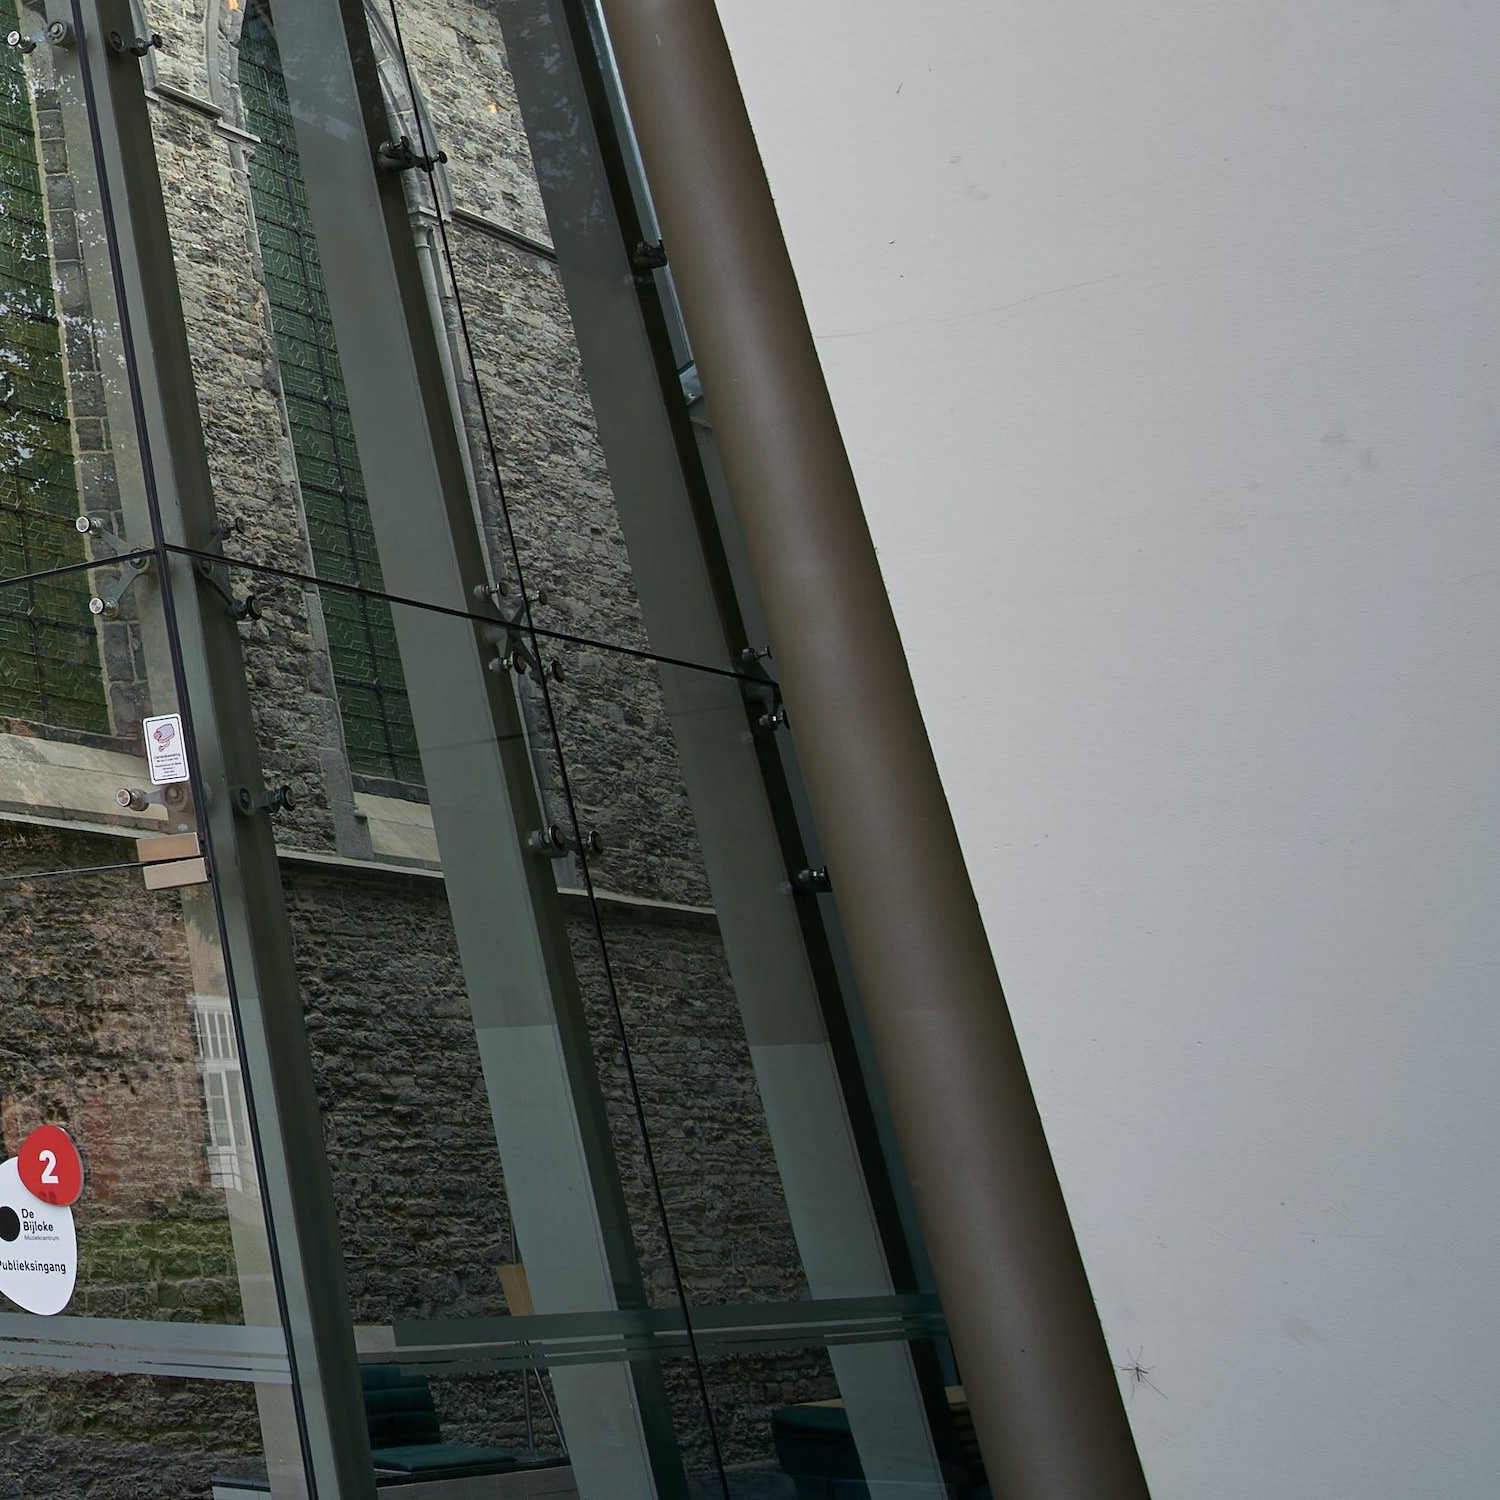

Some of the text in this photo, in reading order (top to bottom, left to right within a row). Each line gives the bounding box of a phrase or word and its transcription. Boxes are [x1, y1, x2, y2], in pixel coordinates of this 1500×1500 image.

[38, 1149, 59, 1184] 2
[21, 1208, 34, 1219] De
[23, 1220, 53, 1234] Bijloke
